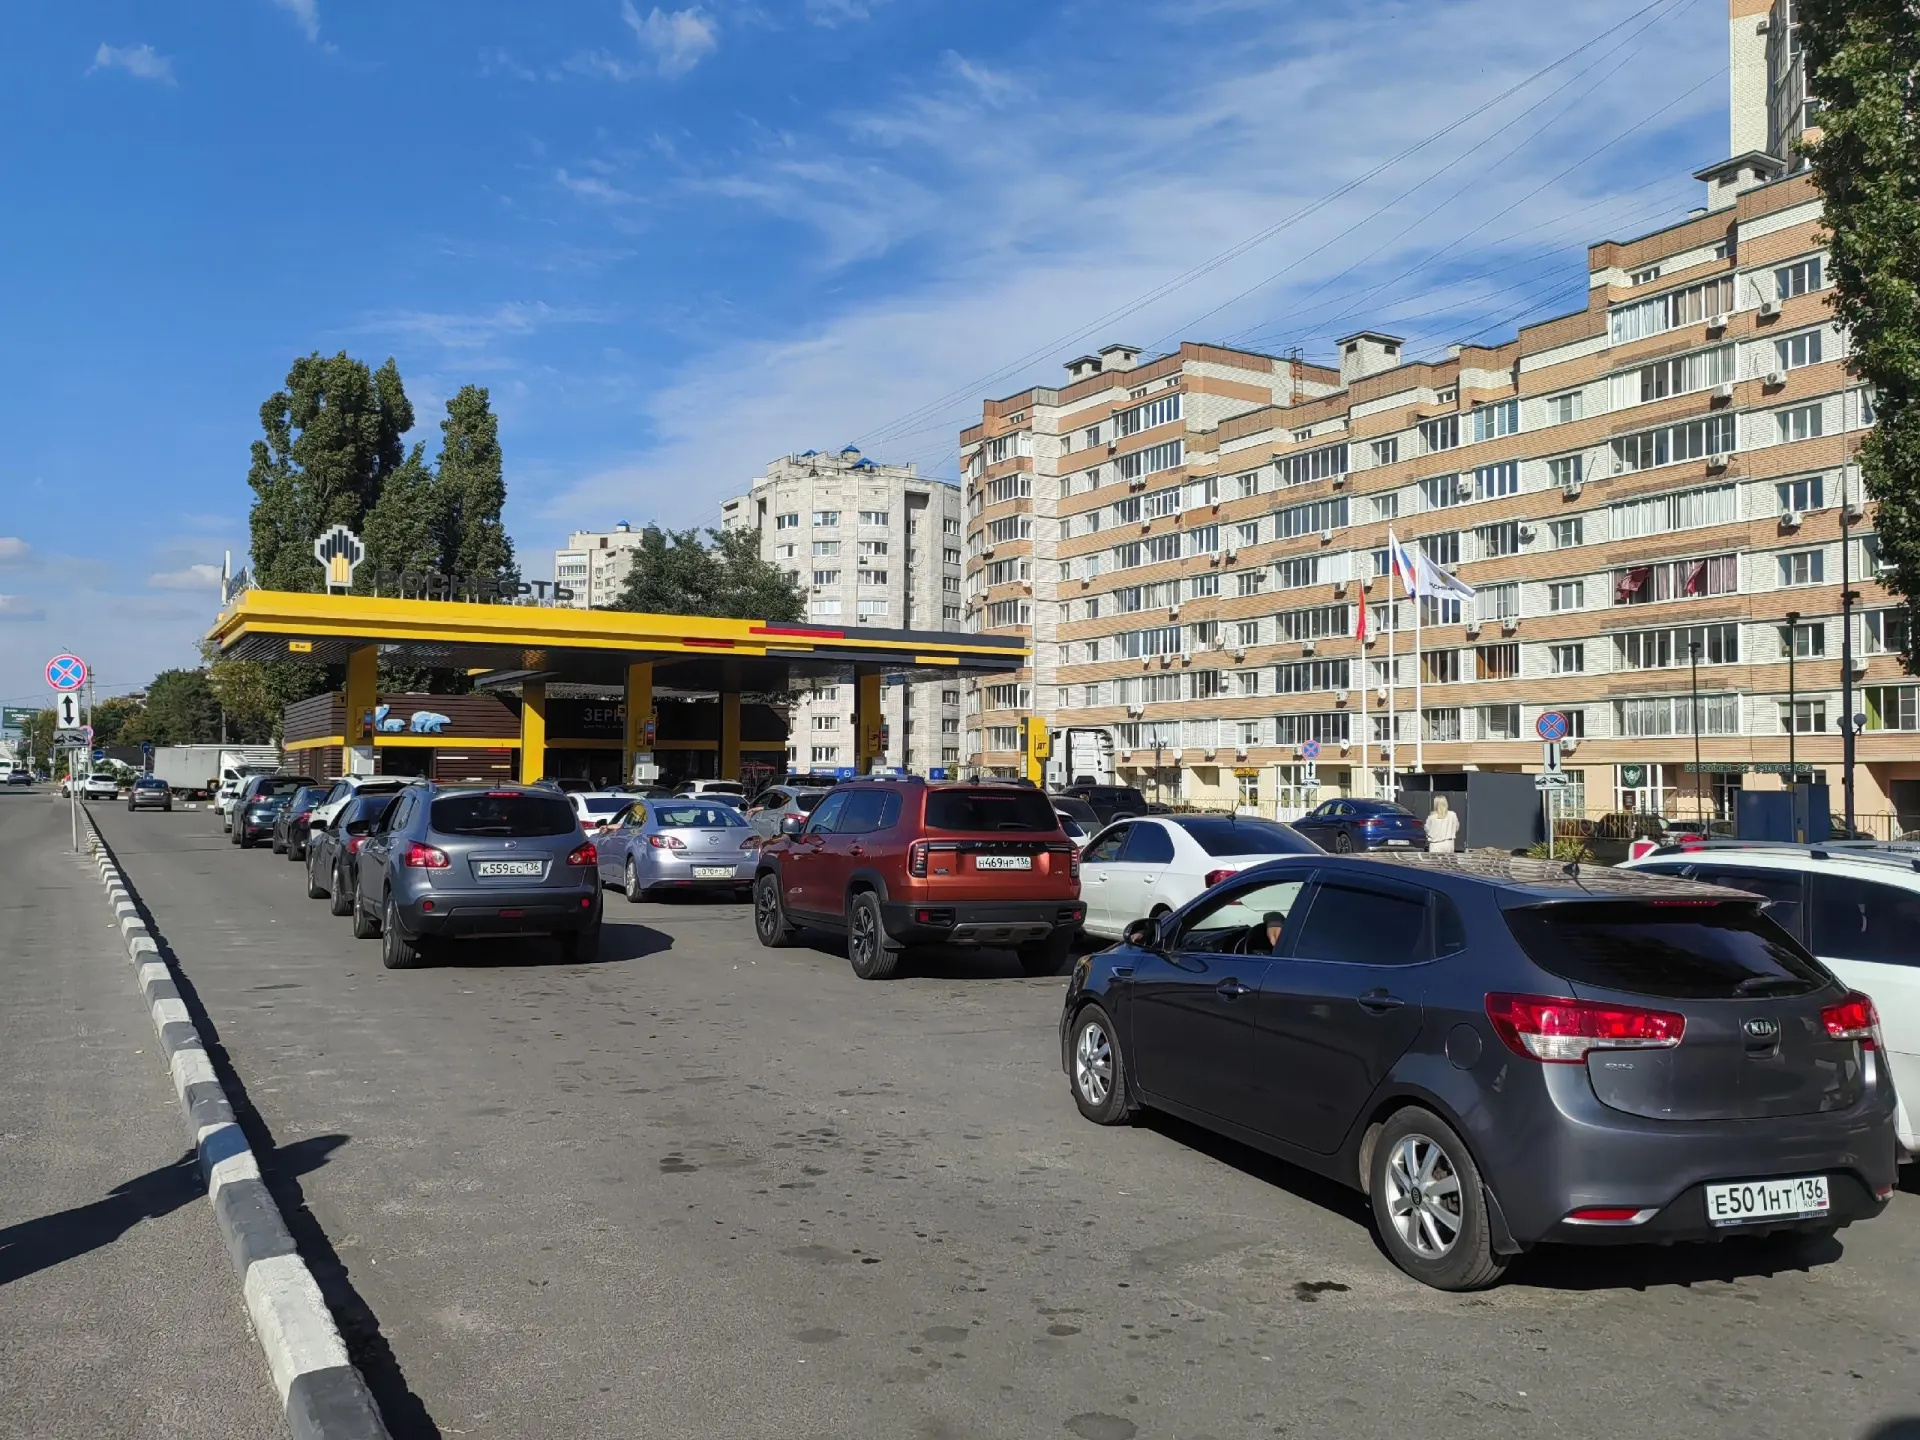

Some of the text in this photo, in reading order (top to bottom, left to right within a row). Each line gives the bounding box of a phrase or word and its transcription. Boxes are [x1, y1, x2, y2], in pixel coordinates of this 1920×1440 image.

[374, 569, 575, 601] РОСНЕФТЬ
[1036, 742, 1047, 750] ДТ
[978, 858, 1014, 868] Н469НР
[482, 864, 523, 875] К559ЕС
[1750, 1021, 1773, 1034] KIA
[1715, 1179, 1824, 1215] Е501НТ 136
